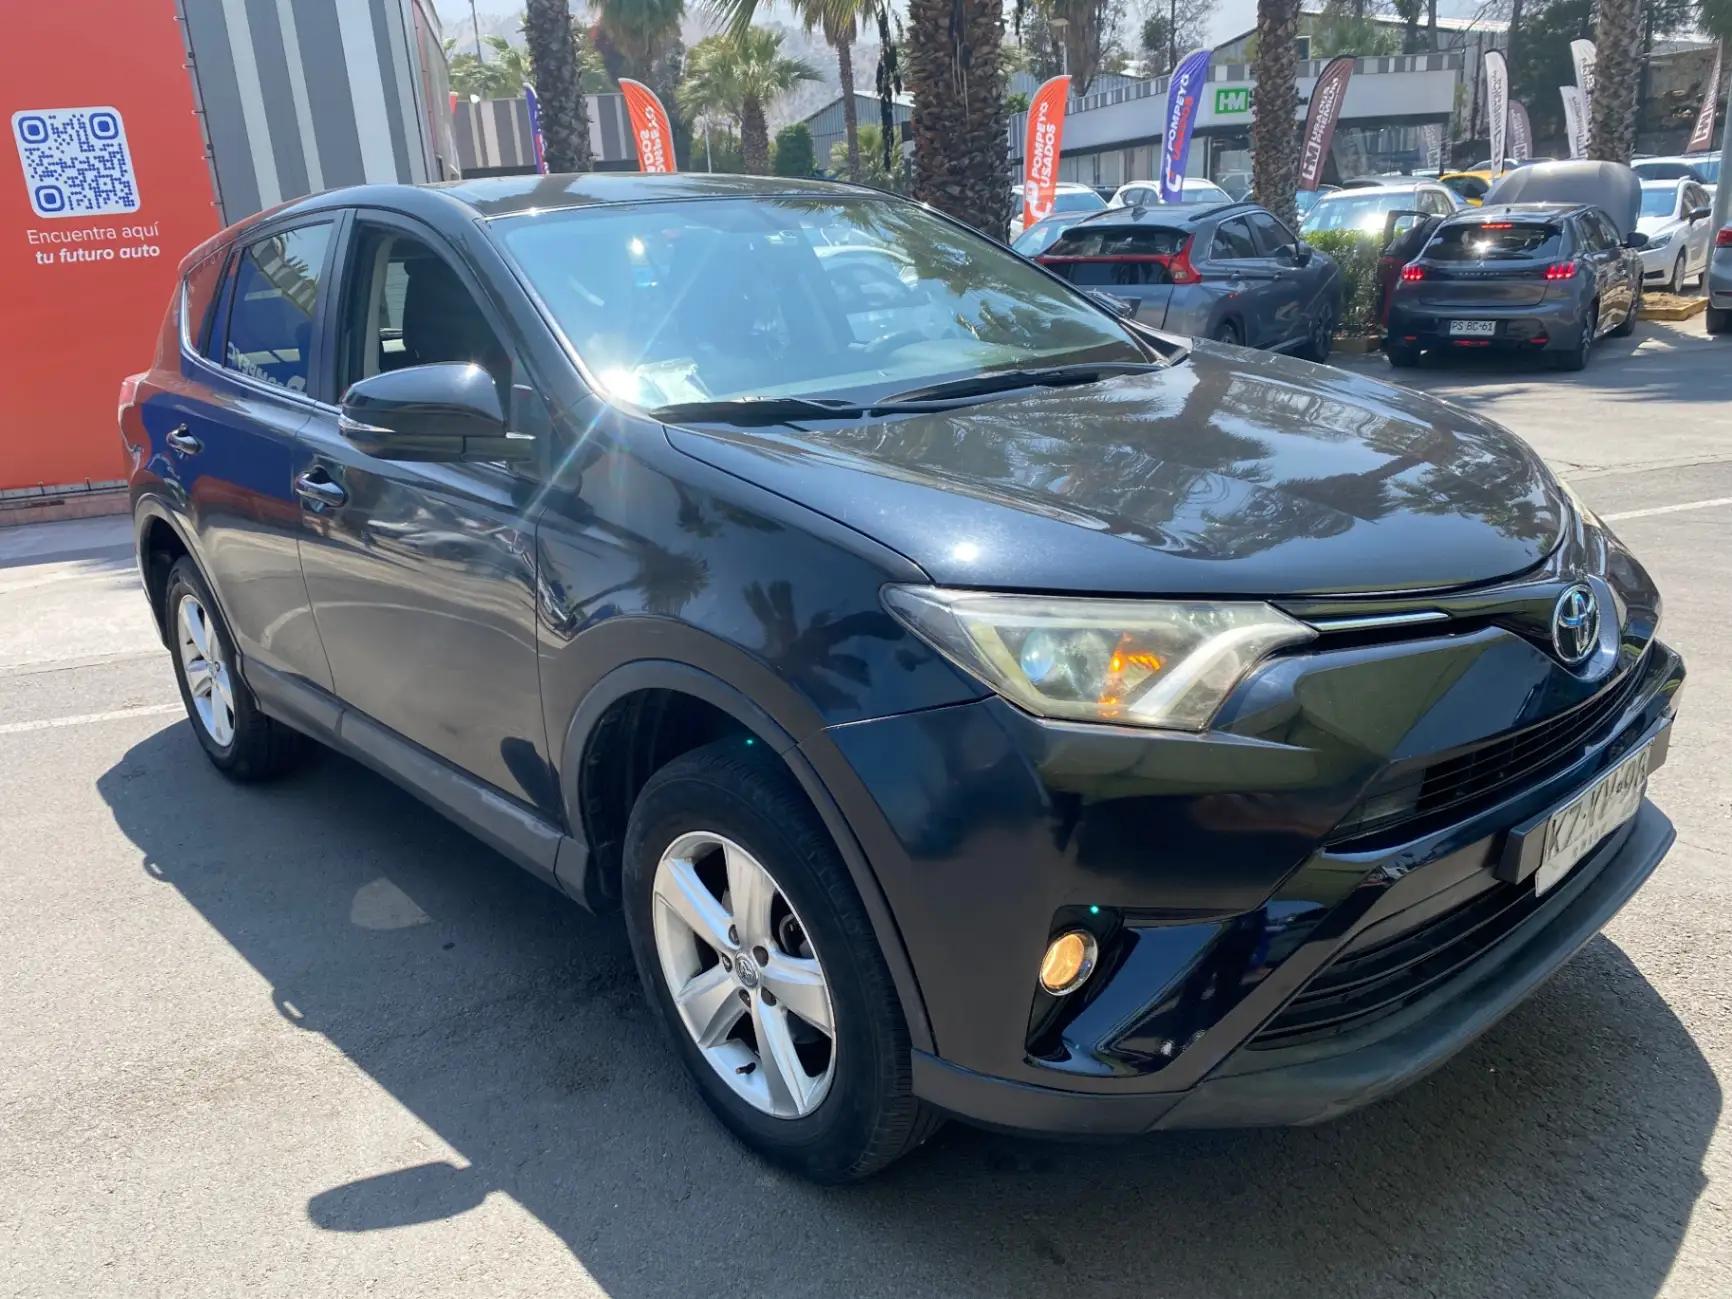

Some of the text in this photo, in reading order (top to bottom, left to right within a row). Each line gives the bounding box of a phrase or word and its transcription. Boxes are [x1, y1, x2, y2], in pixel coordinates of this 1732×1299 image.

[1168, 73, 1190, 151] POMPEYO
[1218, 91, 1247, 111] HM
[1031, 101, 1049, 178] POMPEYO
[1039, 123, 1056, 188] USADOS
[26, 221, 160, 245] Encuentra aquí
[35, 244, 161, 265] tu futuro auto
